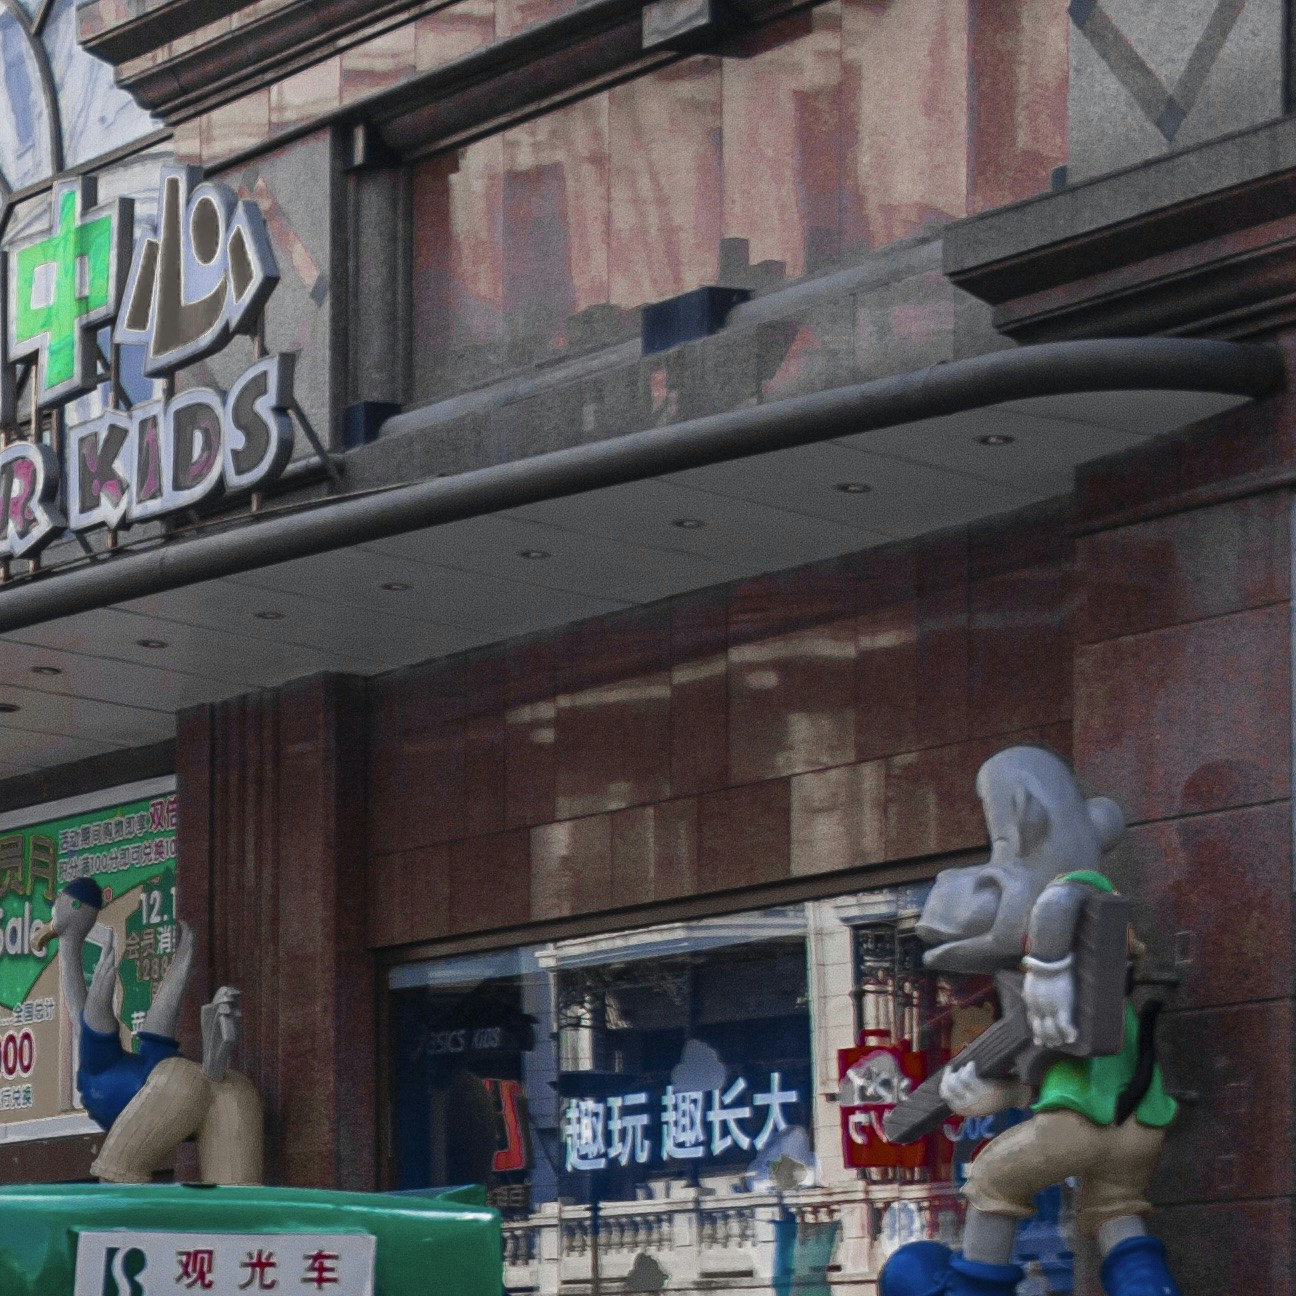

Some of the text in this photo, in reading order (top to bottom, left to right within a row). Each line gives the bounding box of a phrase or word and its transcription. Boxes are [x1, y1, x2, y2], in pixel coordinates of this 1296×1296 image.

[68, 357, 284, 532] KIDS
[174, 1248, 340, 1291] 观光车
